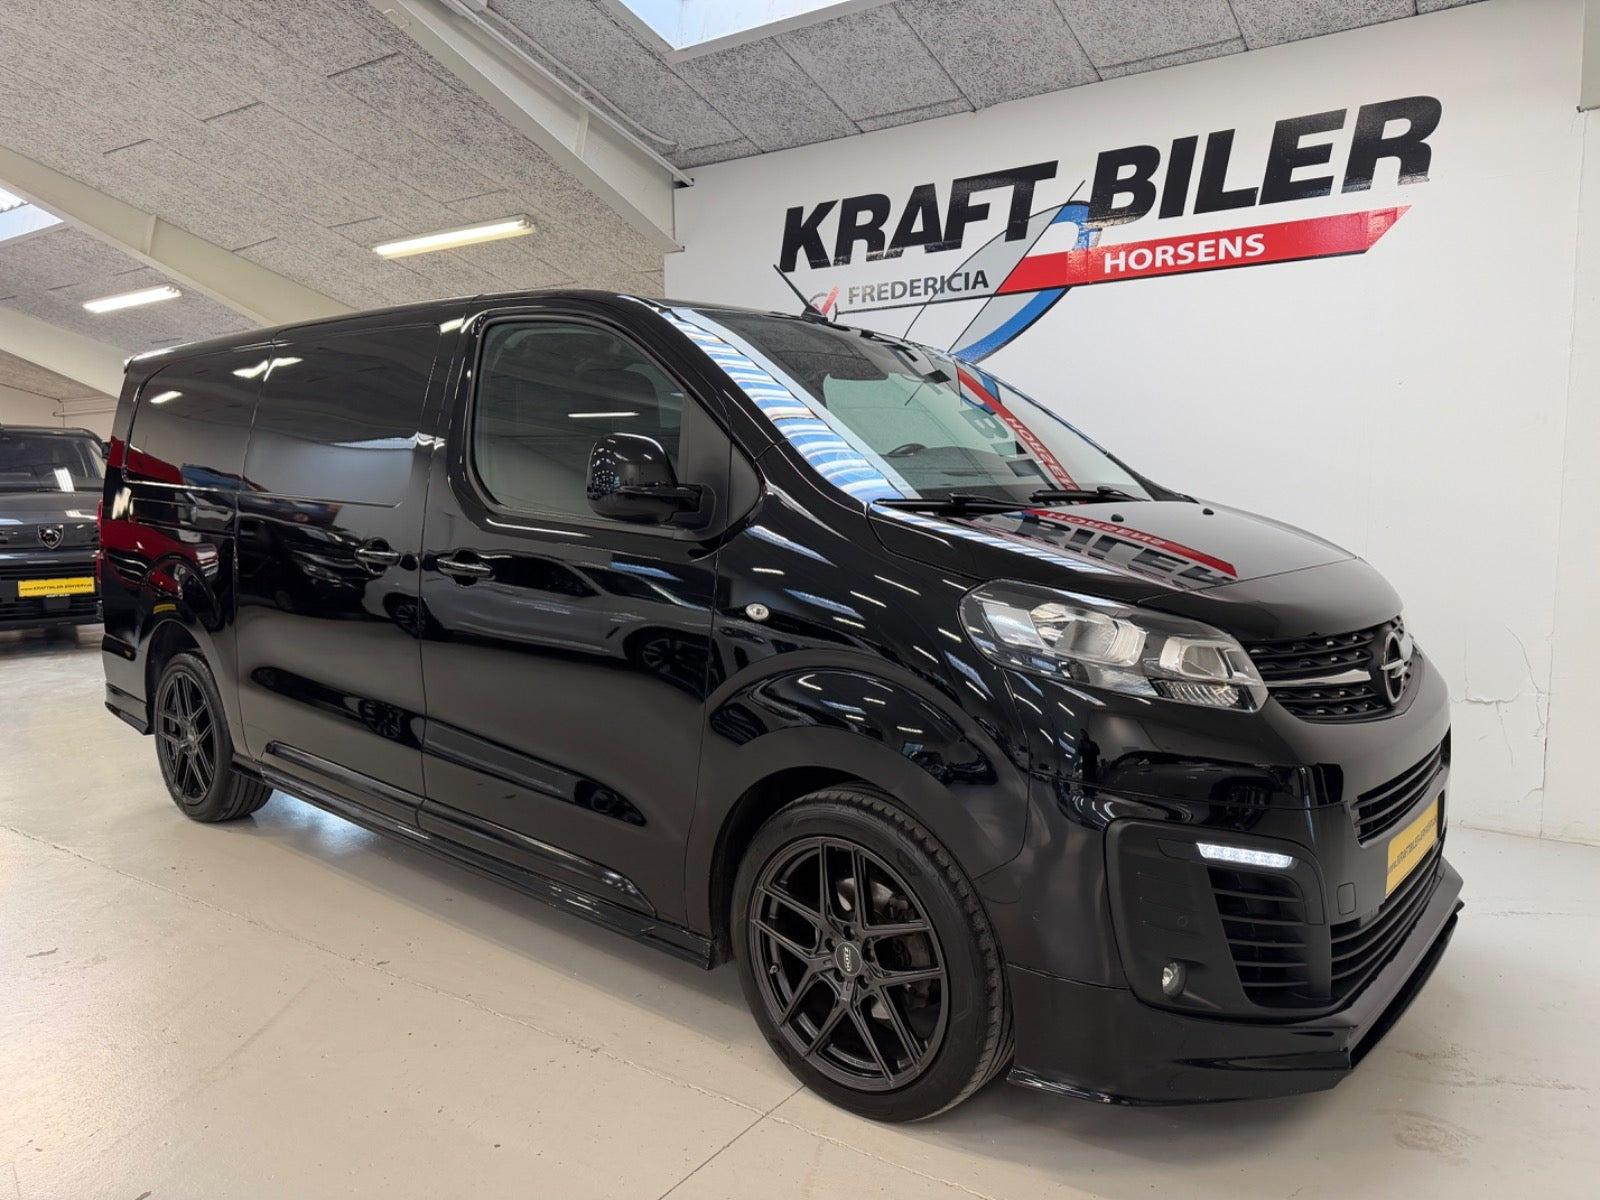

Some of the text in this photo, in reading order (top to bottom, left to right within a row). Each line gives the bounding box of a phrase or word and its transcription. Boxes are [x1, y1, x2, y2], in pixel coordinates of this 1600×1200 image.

[779, 95, 1442, 272] KRAFT BILER
[1104, 233, 1265, 274] HORSENS
[848, 270, 989, 305] FREDERICIA
